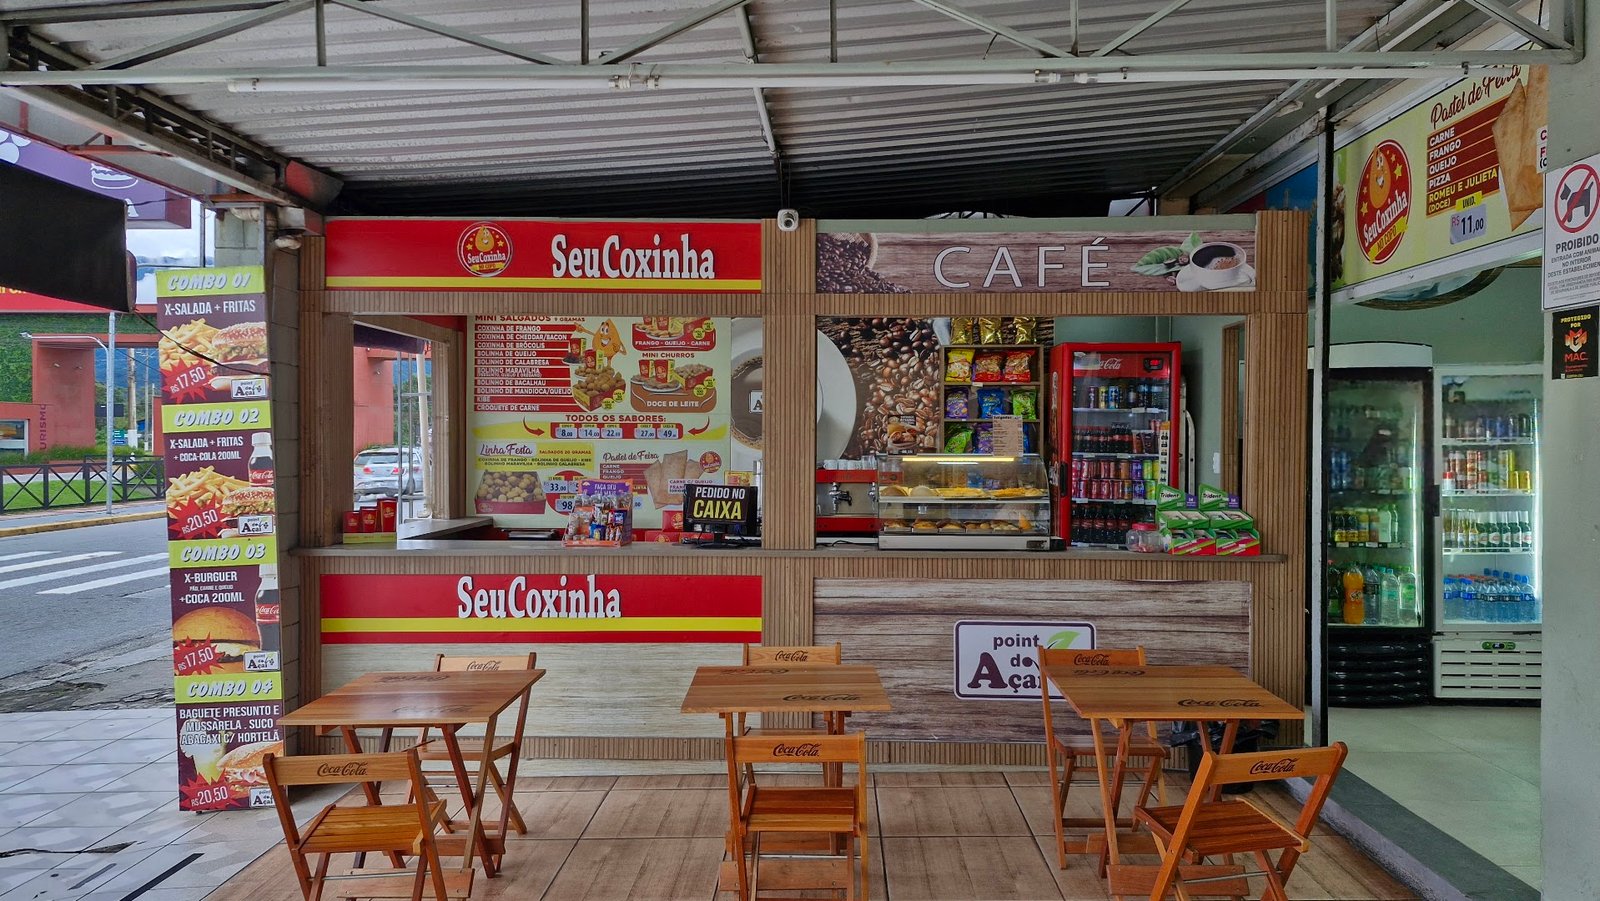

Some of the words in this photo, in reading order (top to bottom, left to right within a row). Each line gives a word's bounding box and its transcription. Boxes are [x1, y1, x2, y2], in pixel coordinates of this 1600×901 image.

[1431, 99, 1466, 129] Pastel
[1468, 86, 1483, 105] de
[1430, 127, 1455, 147] CARNE
[1429, 140, 1461, 161] FRANGO
[1429, 156, 1457, 175] QUEIJO
[1429, 173, 1450, 189] PIZZA
[1429, 186, 1456, 203] ROMEU
[1458, 182, 1463, 192] E
[1465, 168, 1497, 190] JULIETA
[1428, 198, 1451, 214] (DOCE)
[1460, 215, 1484, 236] 11,00
[1555, 233, 1599, 254] PROIBIDO
[933, 236, 1110, 288] CAFÉ
[1551, 253, 1572, 263] ENTRADA
[1573, 250, 1584, 258] COM
[1570, 256, 1592, 266] INTERIOR
[168, 274, 227, 291] COMBO
[231, 272, 251, 288] 01
[1548, 270, 1562, 278] DESTE
[164, 301, 213, 316] X-SALADA
[223, 300, 257, 313] FRITAS
[1560, 314, 1592, 323] PROTEGIDO
[515, 341, 545, 349] BRÓCOLIS
[176, 366, 206, 390] 17,50
[174, 409, 234, 427] COMBO
[240, 408, 260, 424] 02
[565, 414, 598, 422] TODOS
[602, 414, 616, 422] OS
[618, 414, 666, 422] SABORES:
[169, 438, 209, 449] X-SALADA
[217, 436, 244, 447] FRITAS
[480, 443, 506, 456] Linha
[505, 442, 533, 456] Festa
[180, 452, 217, 462] COCA-COLA
[218, 451, 241, 461] 200ML
[603, 452, 628, 462] Pastel
[628, 452, 637, 461] de
[550, 483, 567, 491] 33,00
[695, 487, 729, 499] PEDIDO
[731, 488, 746, 500] NO
[692, 499, 742, 520] CAIXA
[187, 509, 219, 531] 20,50
[181, 545, 240, 562] COMBO
[245, 543, 266, 559] 03
[184, 571, 238, 583] X-BURGUER
[212, 592, 245, 603] 200ML
[993, 634, 1040, 650] point
[184, 646, 214, 668] 17,50
[187, 681, 246, 697] COMBO
[251, 680, 273, 694] 04
[179, 707, 221, 719] BAGUETE
[223, 705, 271, 718] PRESUNTO
[273, 705, 280, 715] E
[186, 719, 242, 732] MUSSARELA
[249, 718, 274, 729] SUCO
[223, 733, 235, 744] C/
[238, 729, 280, 743] HORTELÃ
[196, 786, 228, 805] 20,50
